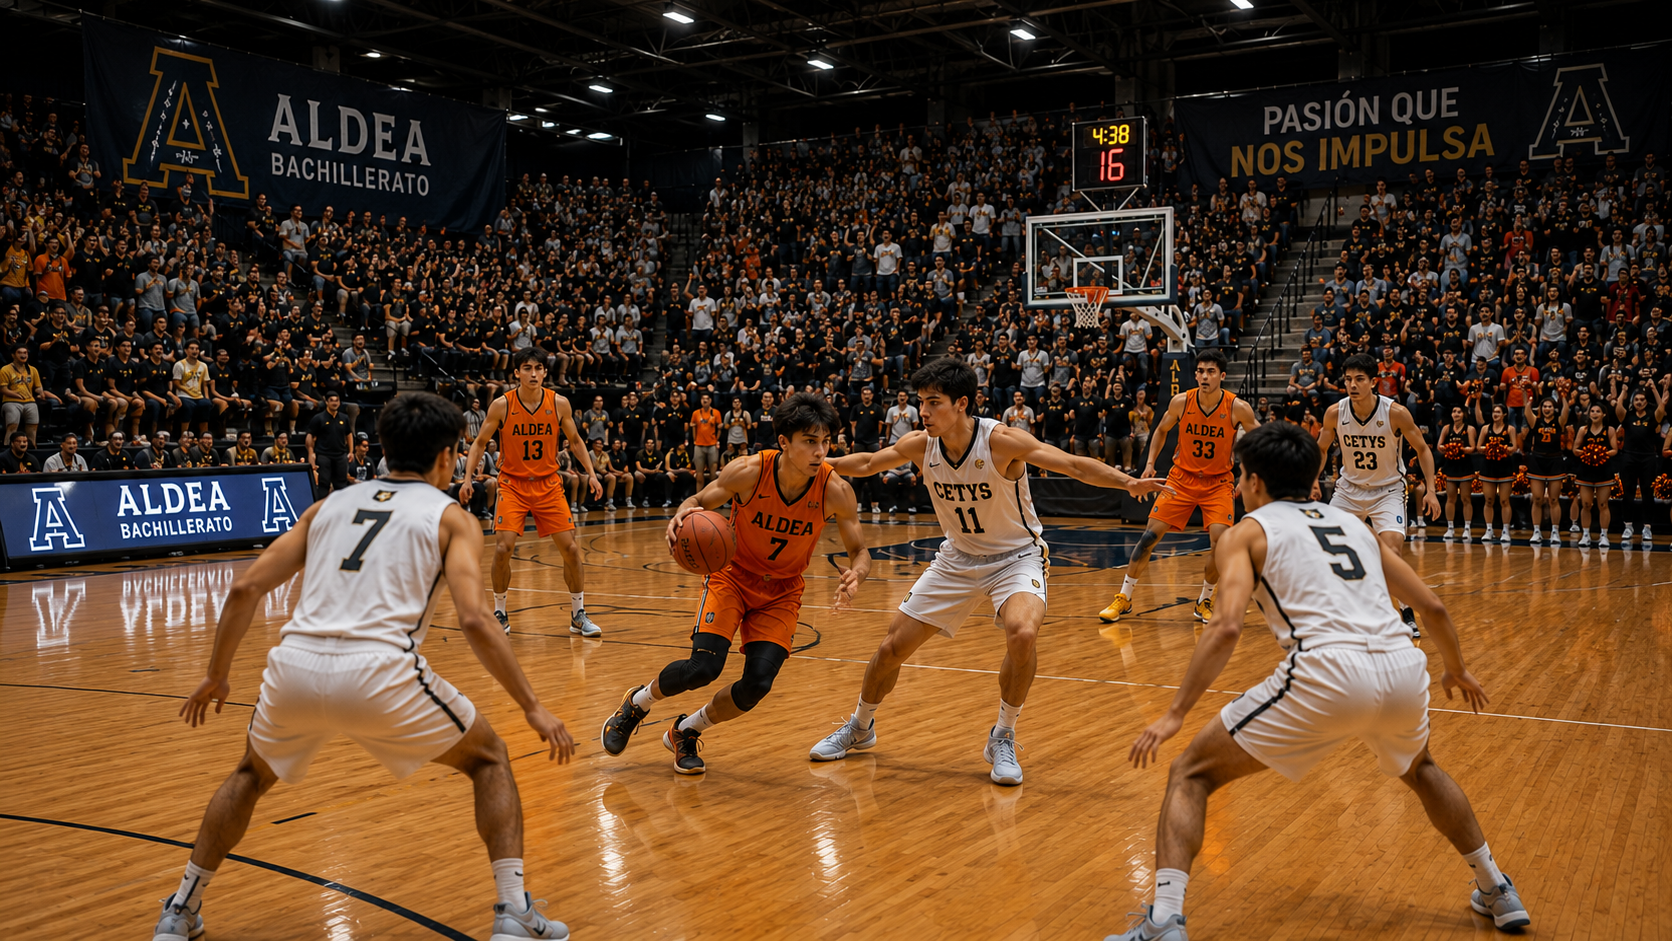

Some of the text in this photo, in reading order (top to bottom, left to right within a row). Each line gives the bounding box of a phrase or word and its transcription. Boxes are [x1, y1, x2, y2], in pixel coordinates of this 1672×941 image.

[122, 46, 249, 199] A
[1264, 87, 1460, 135] PASIÓN QUE
[268, 93, 431, 167] ALDEA
[1093, 124, 1130, 145] 4:38
[1230, 123, 1496, 178] NOS IMPULSA
[271, 152, 430, 197] BACHILLERATO
[1100, 148, 1124, 181] 16
[512, 423, 553, 436] ALDEA
[1185, 422, 1225, 438] ALDEA
[1343, 434, 1386, 449] CETYS
[522, 440, 543, 461] 13
[1192, 440, 1215, 459] 33
[1353, 450, 1378, 470] 23
[117, 480, 231, 517] ALDEA
[261, 477, 299, 533] A
[934, 481, 992, 502] CETYS
[29, 487, 85, 551] A
[119, 515, 233, 539] BACHILLERATO
[751, 511, 813, 536] ALDEA
[954, 507, 985, 534] 11
[339, 509, 392, 571] 7
[767, 537, 788, 561] 7
[1309, 525, 1366, 581] 5
